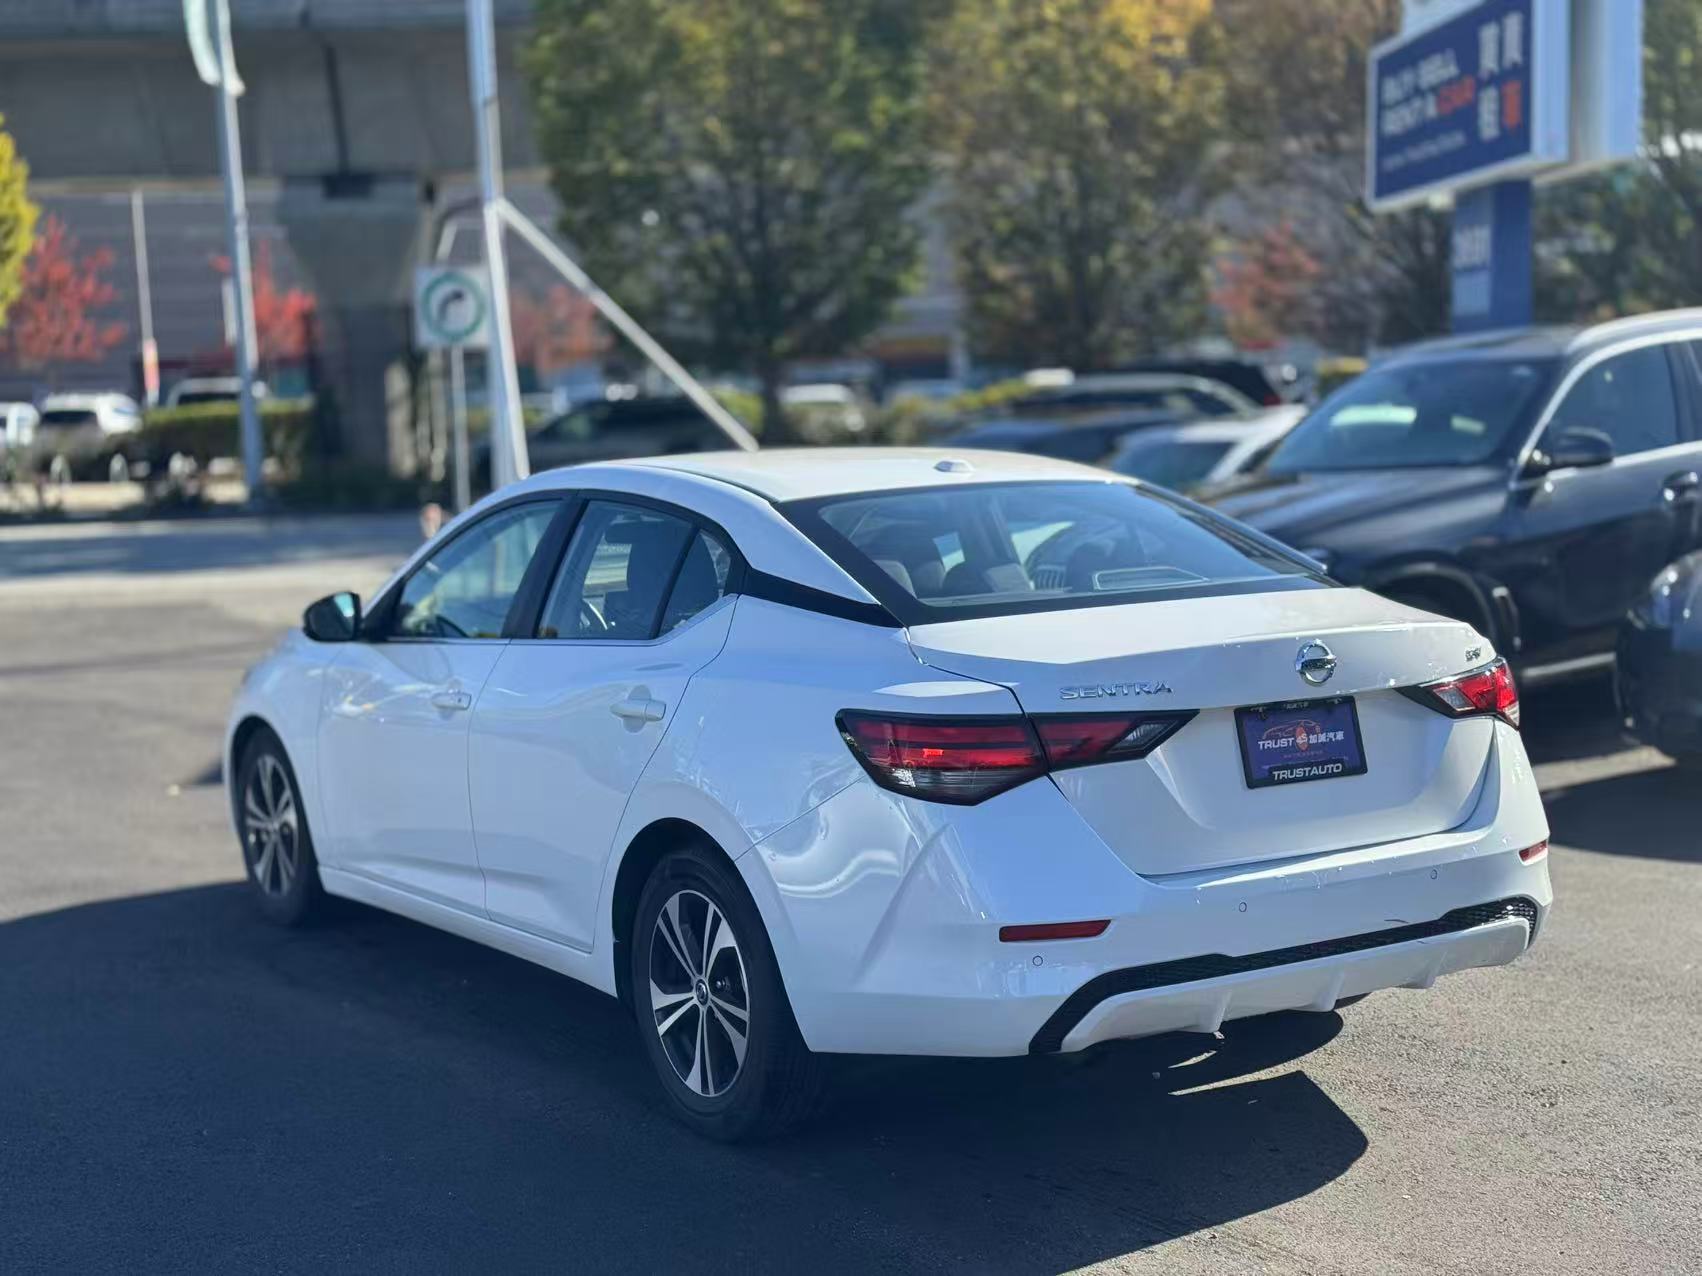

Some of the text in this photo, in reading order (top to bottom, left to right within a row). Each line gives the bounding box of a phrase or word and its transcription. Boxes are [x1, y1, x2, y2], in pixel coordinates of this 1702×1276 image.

[1059, 681, 1173, 700] SENTRA
[1258, 737, 1295, 750] TRUST
[1272, 762, 1343, 781] TRUSTAUTO
